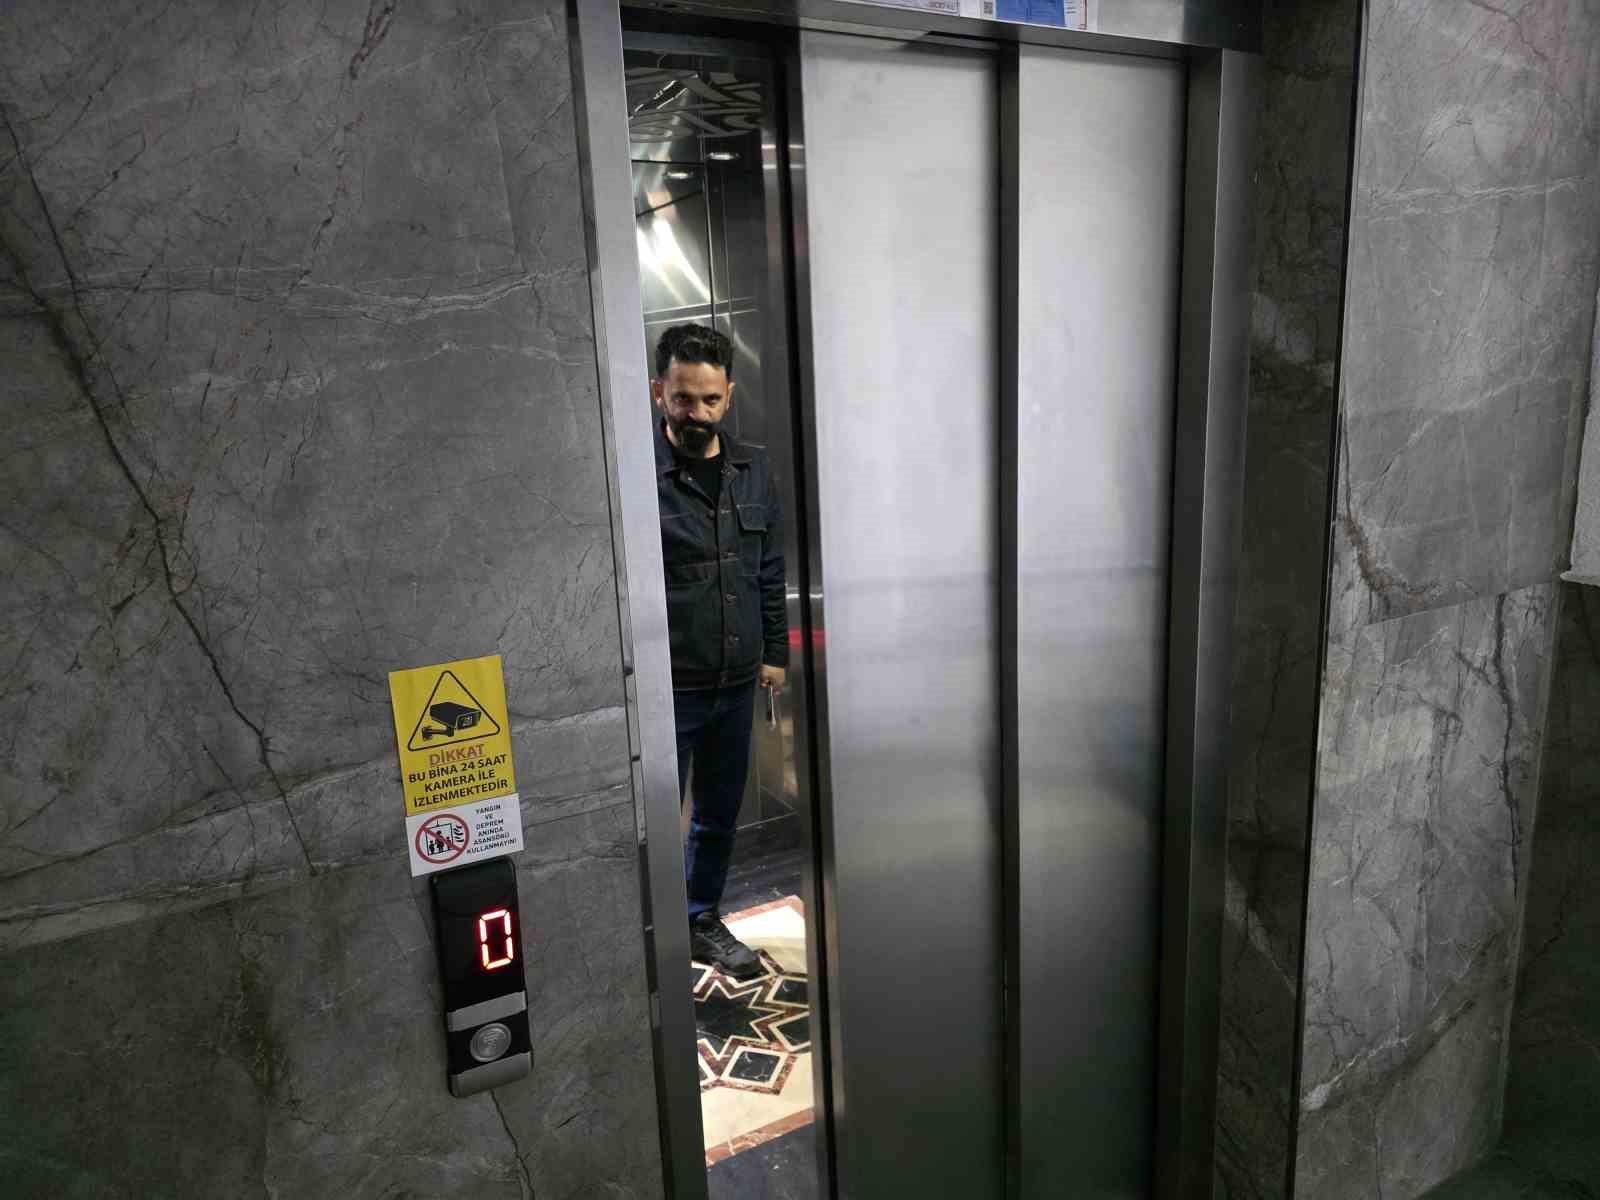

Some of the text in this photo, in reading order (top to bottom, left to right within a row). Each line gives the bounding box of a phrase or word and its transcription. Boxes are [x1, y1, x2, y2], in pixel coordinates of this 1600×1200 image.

[408, 753, 507, 784] BU BİNA 24 SAAT
[430, 744, 485, 766] DİKKAT
[414, 779, 508, 808] İZLENMEKTEDİR
[424, 768, 495, 793] KAMERA İLE
[479, 909, 514, 970] 0
